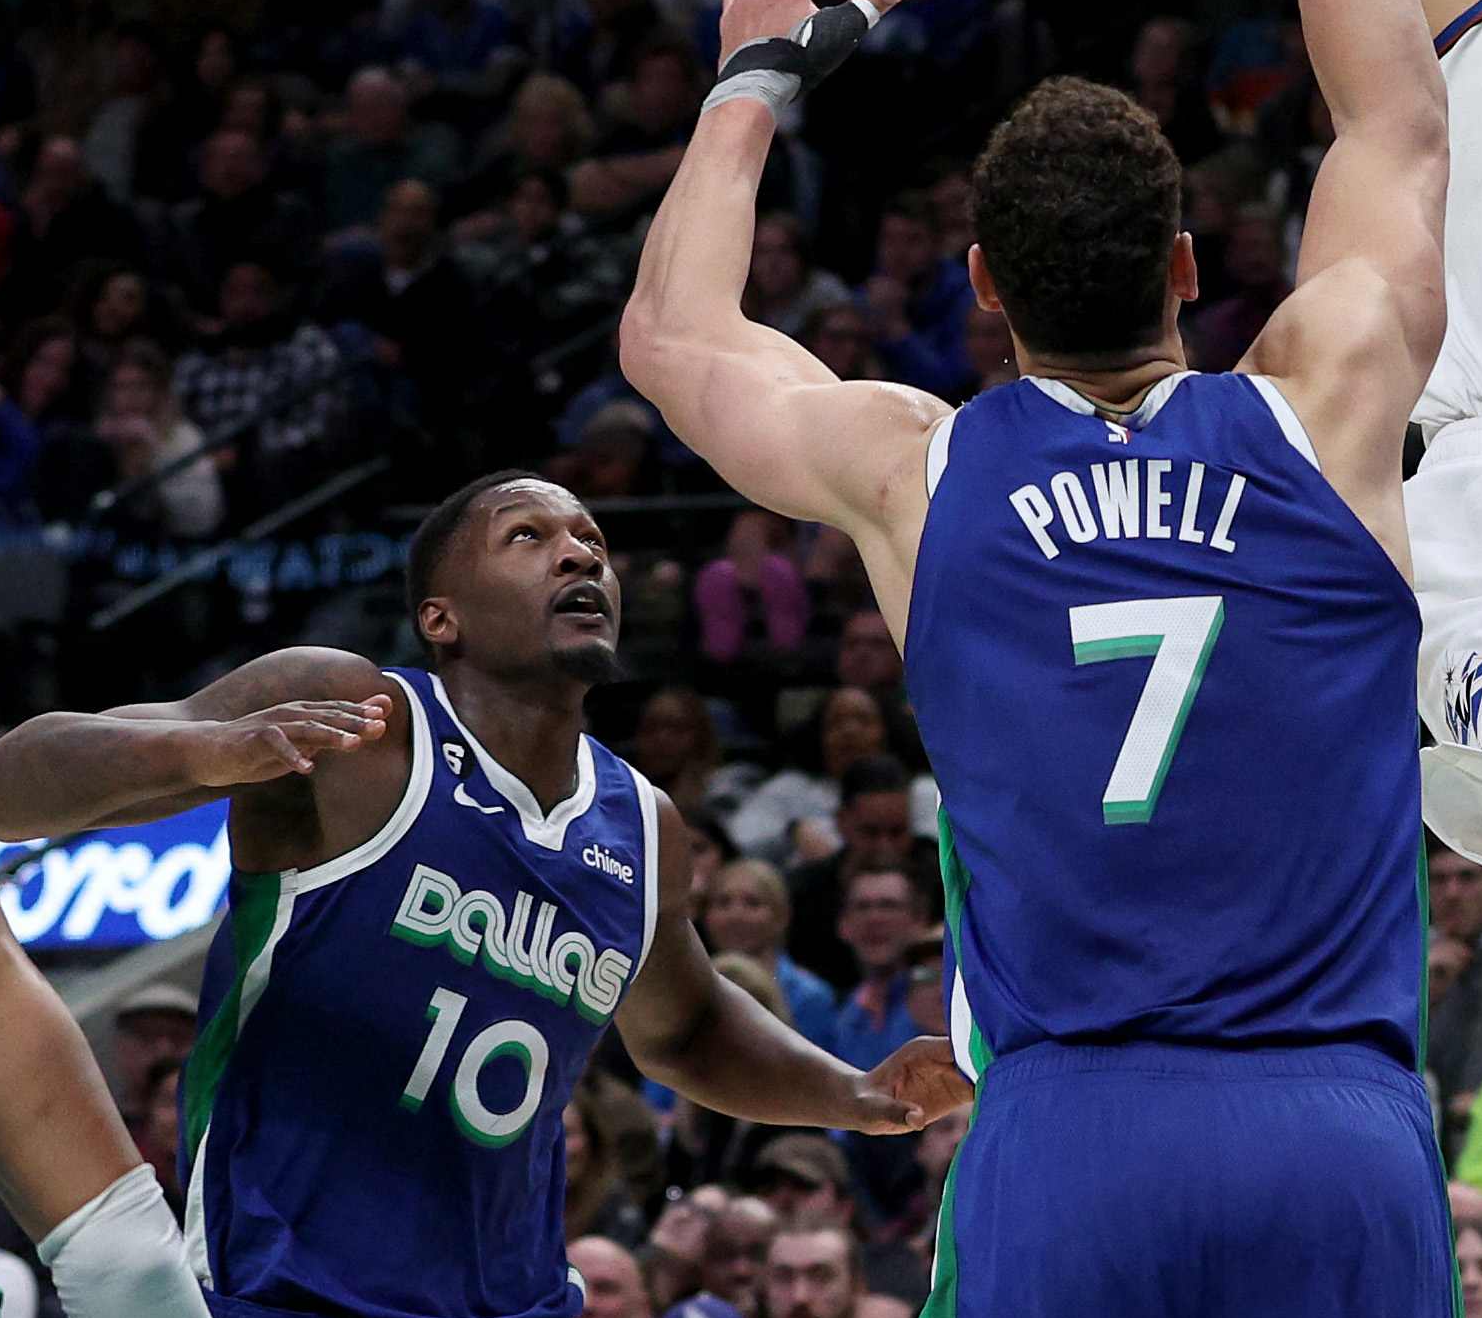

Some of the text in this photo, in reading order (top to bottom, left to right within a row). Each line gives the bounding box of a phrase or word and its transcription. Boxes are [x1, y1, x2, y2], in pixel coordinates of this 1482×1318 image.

[1008, 457, 1248, 561] POWELL
[441, 741, 466, 776] 6
[1069, 595, 1226, 826] 7
[582, 843, 635, 885] chime
[398, 985, 550, 1149] 10
